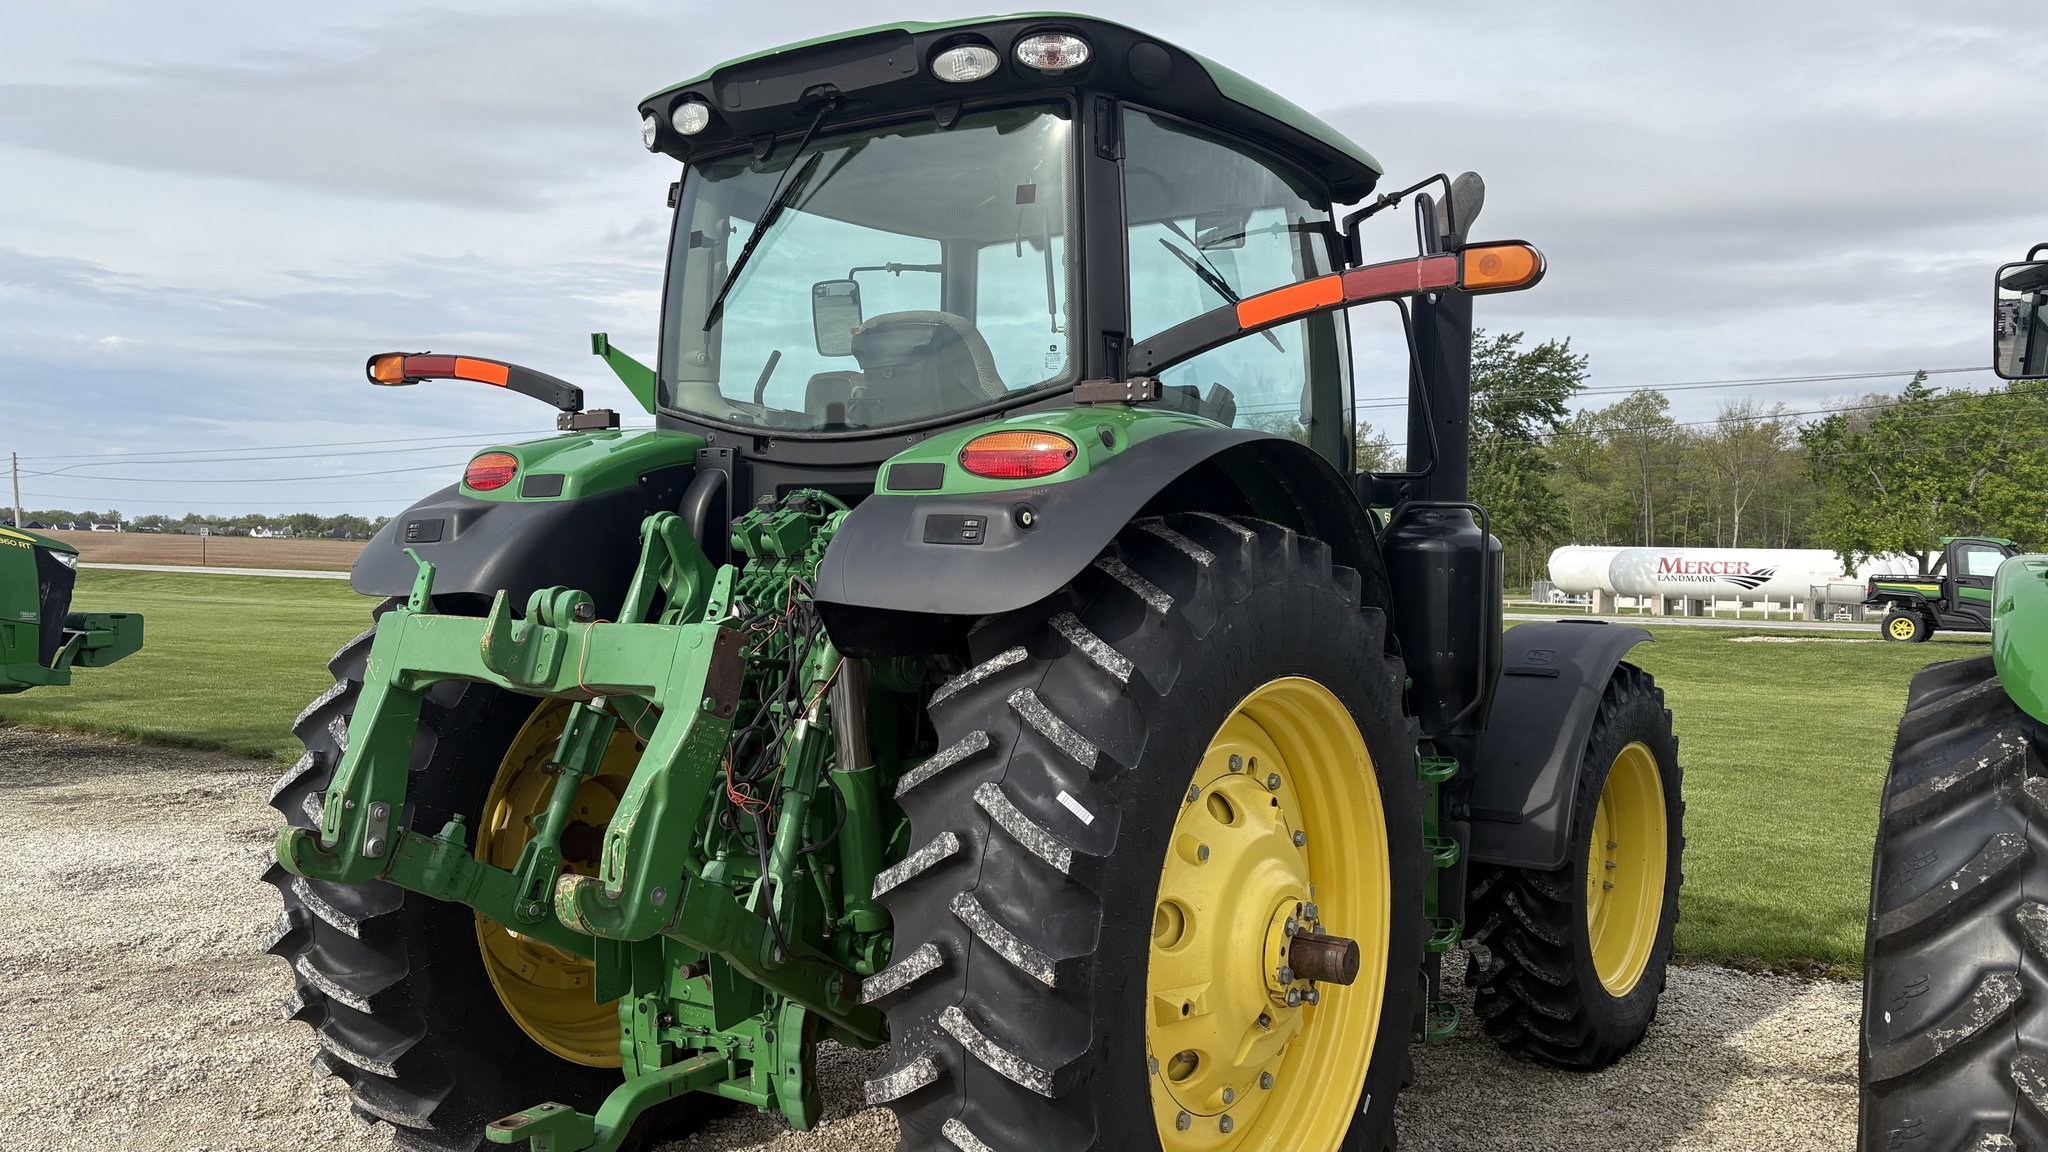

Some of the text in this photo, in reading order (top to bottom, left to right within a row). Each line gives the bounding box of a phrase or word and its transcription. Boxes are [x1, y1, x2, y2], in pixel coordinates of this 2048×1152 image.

[18, 541, 31, 549] RT
[1657, 557, 1751, 574] MERCER
[1657, 574, 1716, 582] LANDMARK
